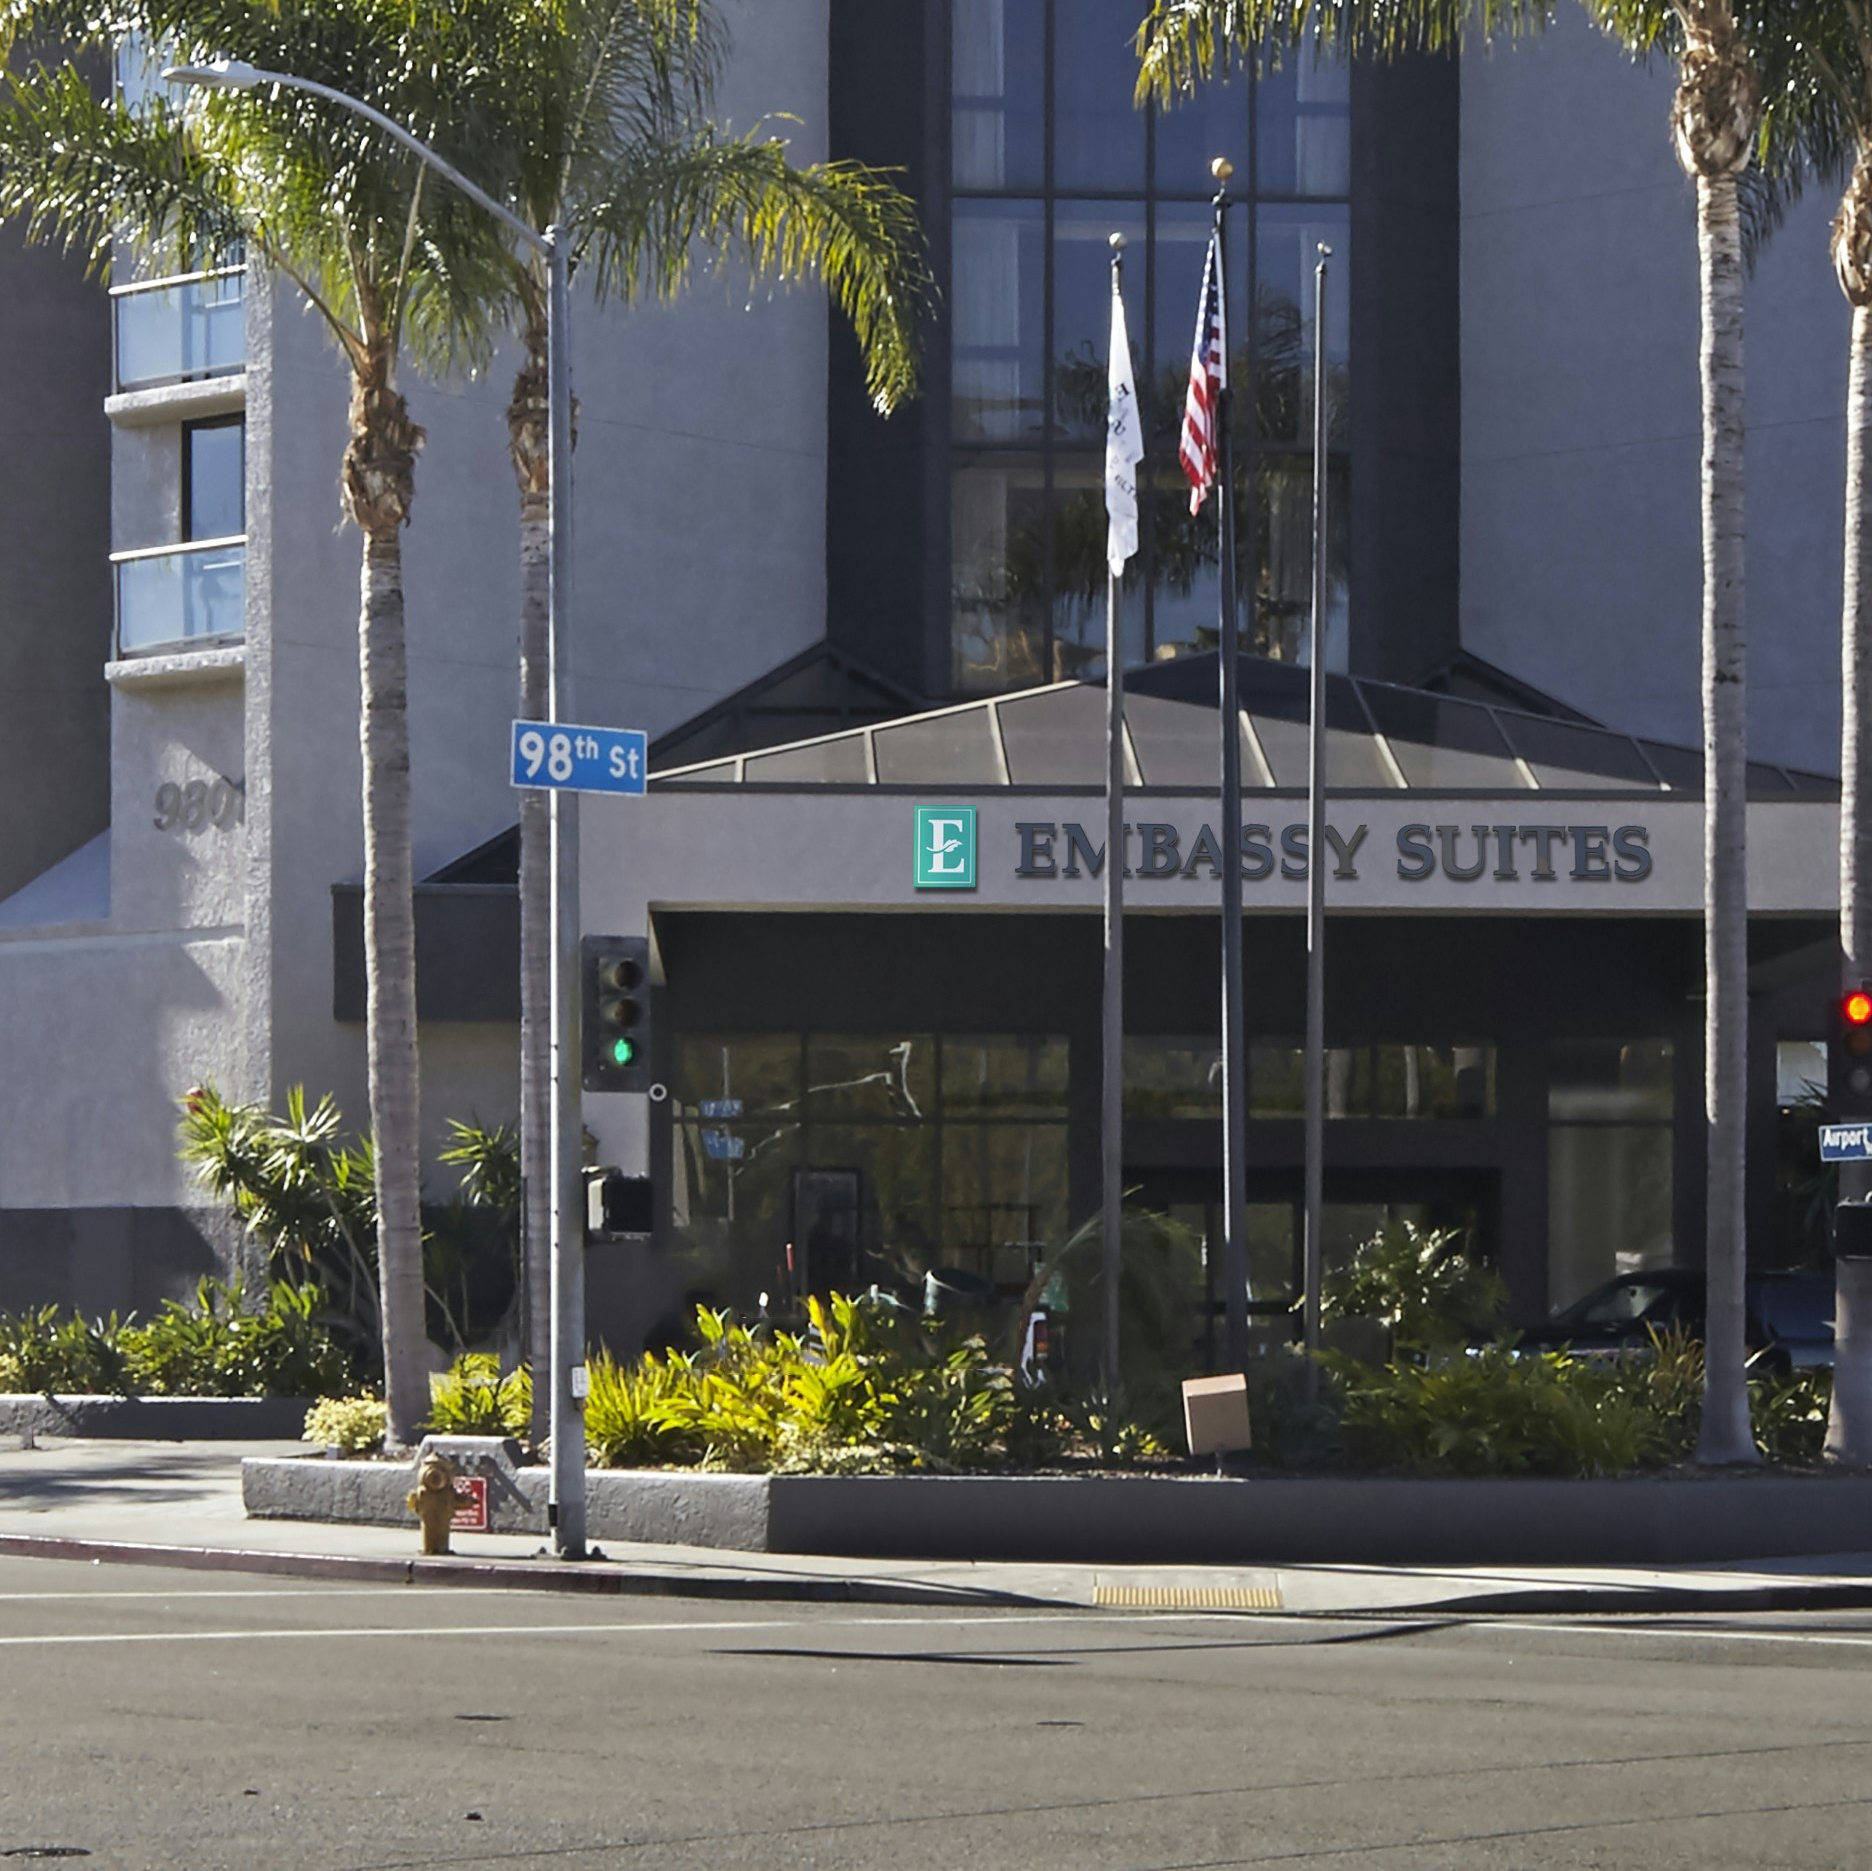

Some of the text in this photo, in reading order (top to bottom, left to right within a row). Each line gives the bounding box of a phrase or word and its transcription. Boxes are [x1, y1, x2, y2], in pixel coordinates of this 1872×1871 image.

[519, 731, 639, 781] 98th St
[926, 819, 964, 873] E
[1015, 823, 1653, 878] EMBASSY SUITES
[1823, 1128, 1868, 1150] Airport
